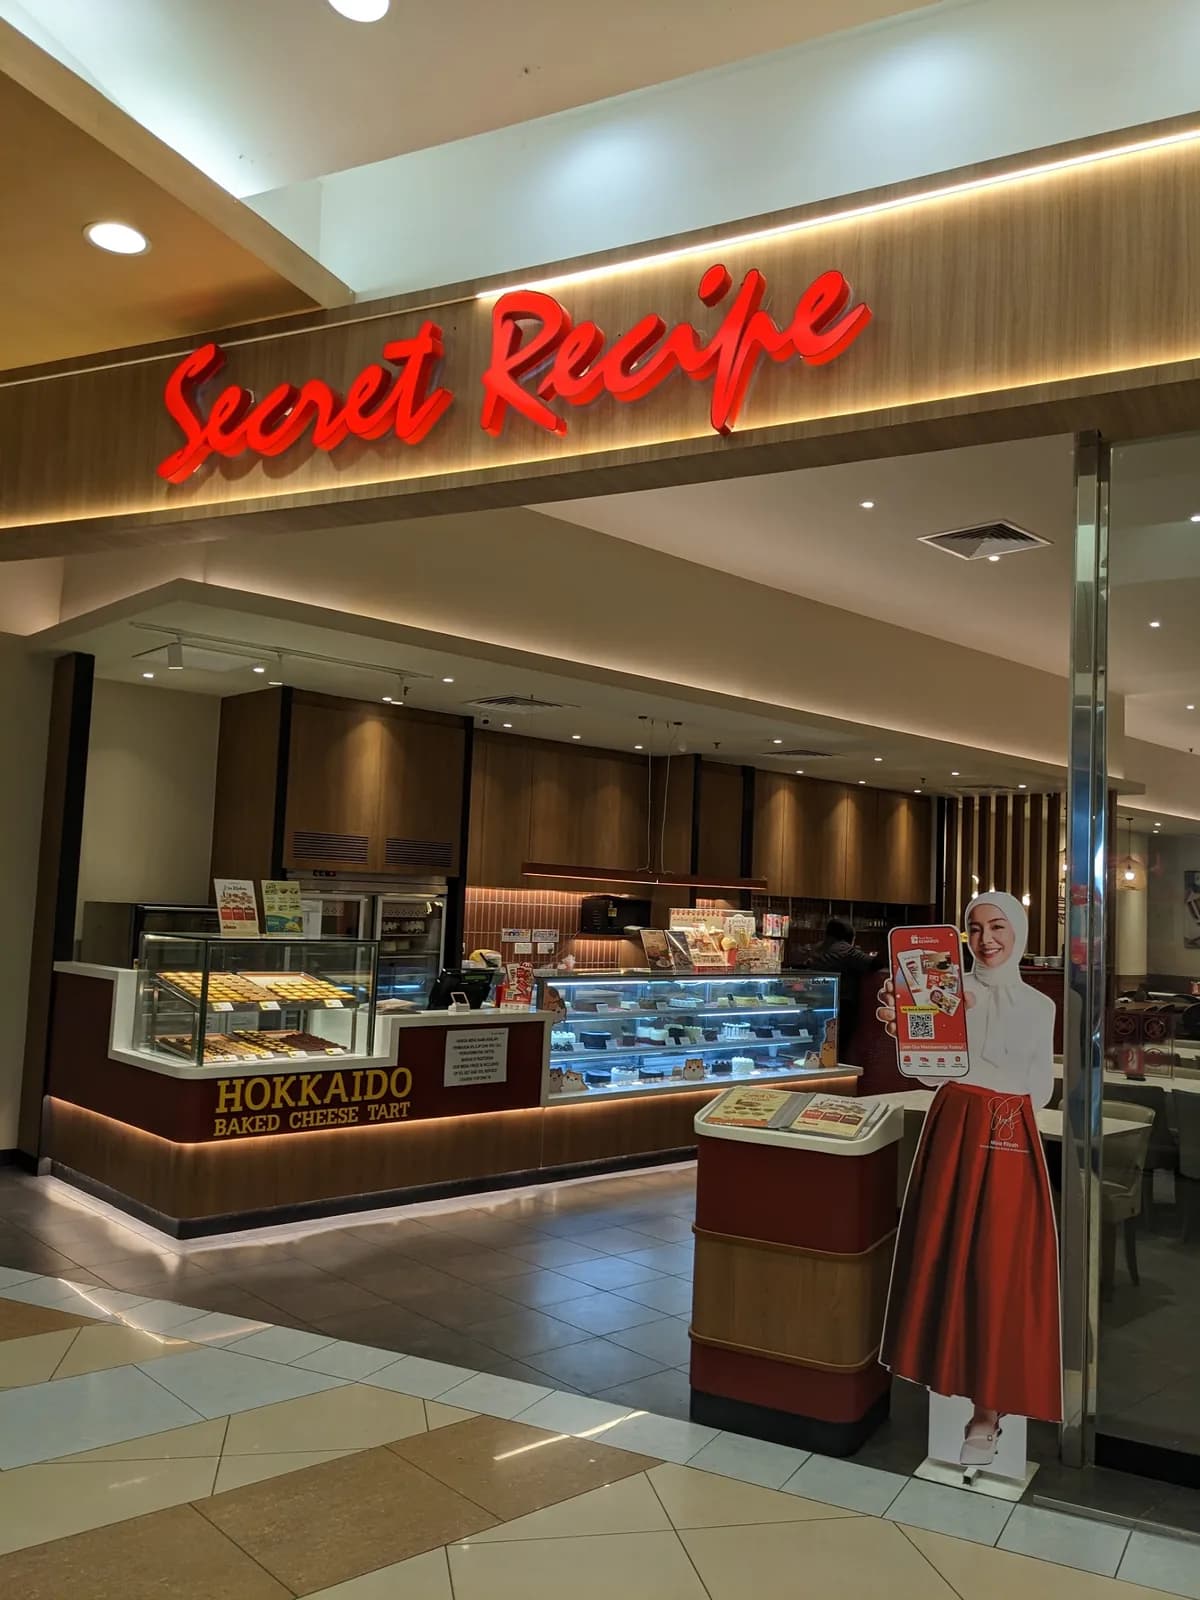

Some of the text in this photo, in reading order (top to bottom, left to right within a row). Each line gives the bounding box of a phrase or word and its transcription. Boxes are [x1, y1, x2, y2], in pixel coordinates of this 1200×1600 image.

[156, 264, 872, 484] Secret Recipe
[215, 1067, 413, 1113] HOKKAIDO
[213, 1101, 411, 1137] BAKED CHEESE TART
